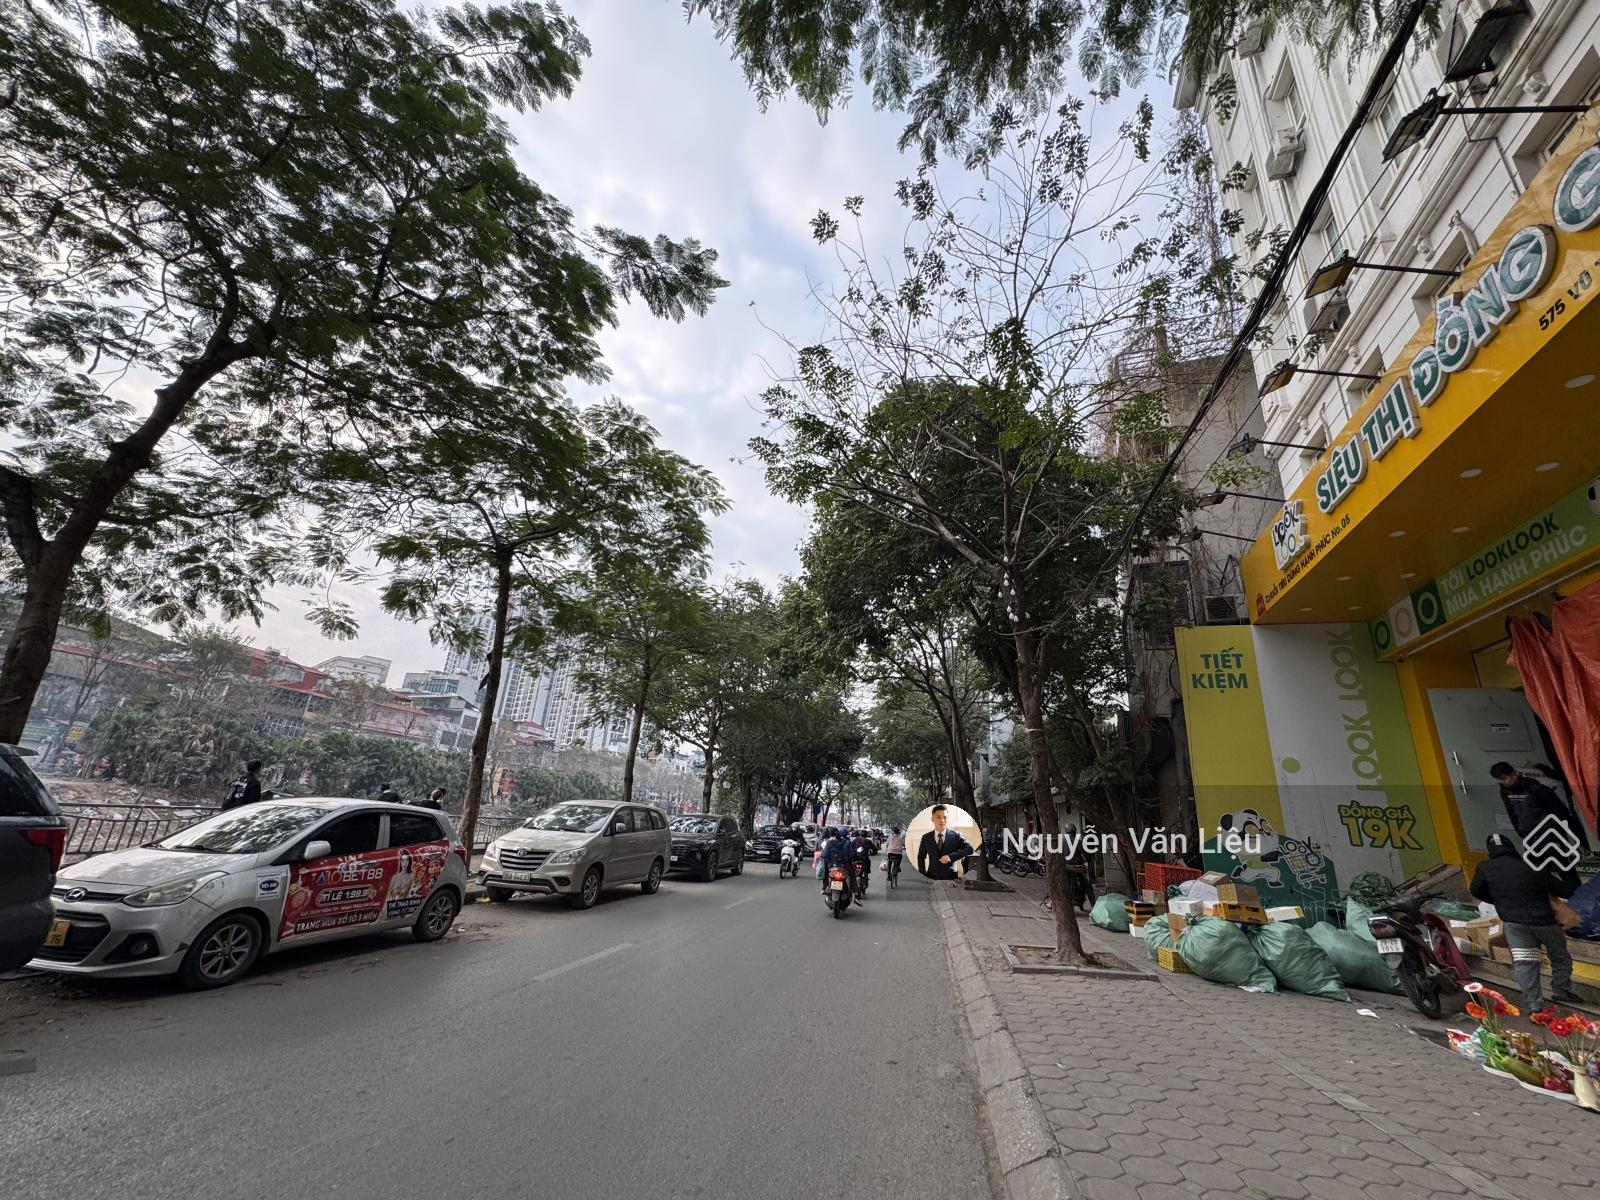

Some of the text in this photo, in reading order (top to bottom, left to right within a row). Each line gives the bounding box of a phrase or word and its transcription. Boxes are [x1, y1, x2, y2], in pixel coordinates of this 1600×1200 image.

[1538, 298, 1566, 331] 575
[1316, 435, 1364, 513] SIÊU
[1361, 377, 1417, 461] THỊ
[1409, 226, 1552, 407] ĐỒNG
[1300, 552, 1316, 570] HẠNH
[1315, 534, 1331, 555] PHÚC
[1466, 512, 1559, 580] LOOKLOOK
[1445, 525, 1588, 614] MUA HẠNH PHÚC
[1199, 646, 1244, 669] TIẾT
[1191, 669, 1249, 694] KIỆM
[1325, 627, 1387, 792] LOOK LOOK
[1338, 800, 1416, 820] ĐỒNG GIÁ
[1340, 817, 1423, 850] 19K
